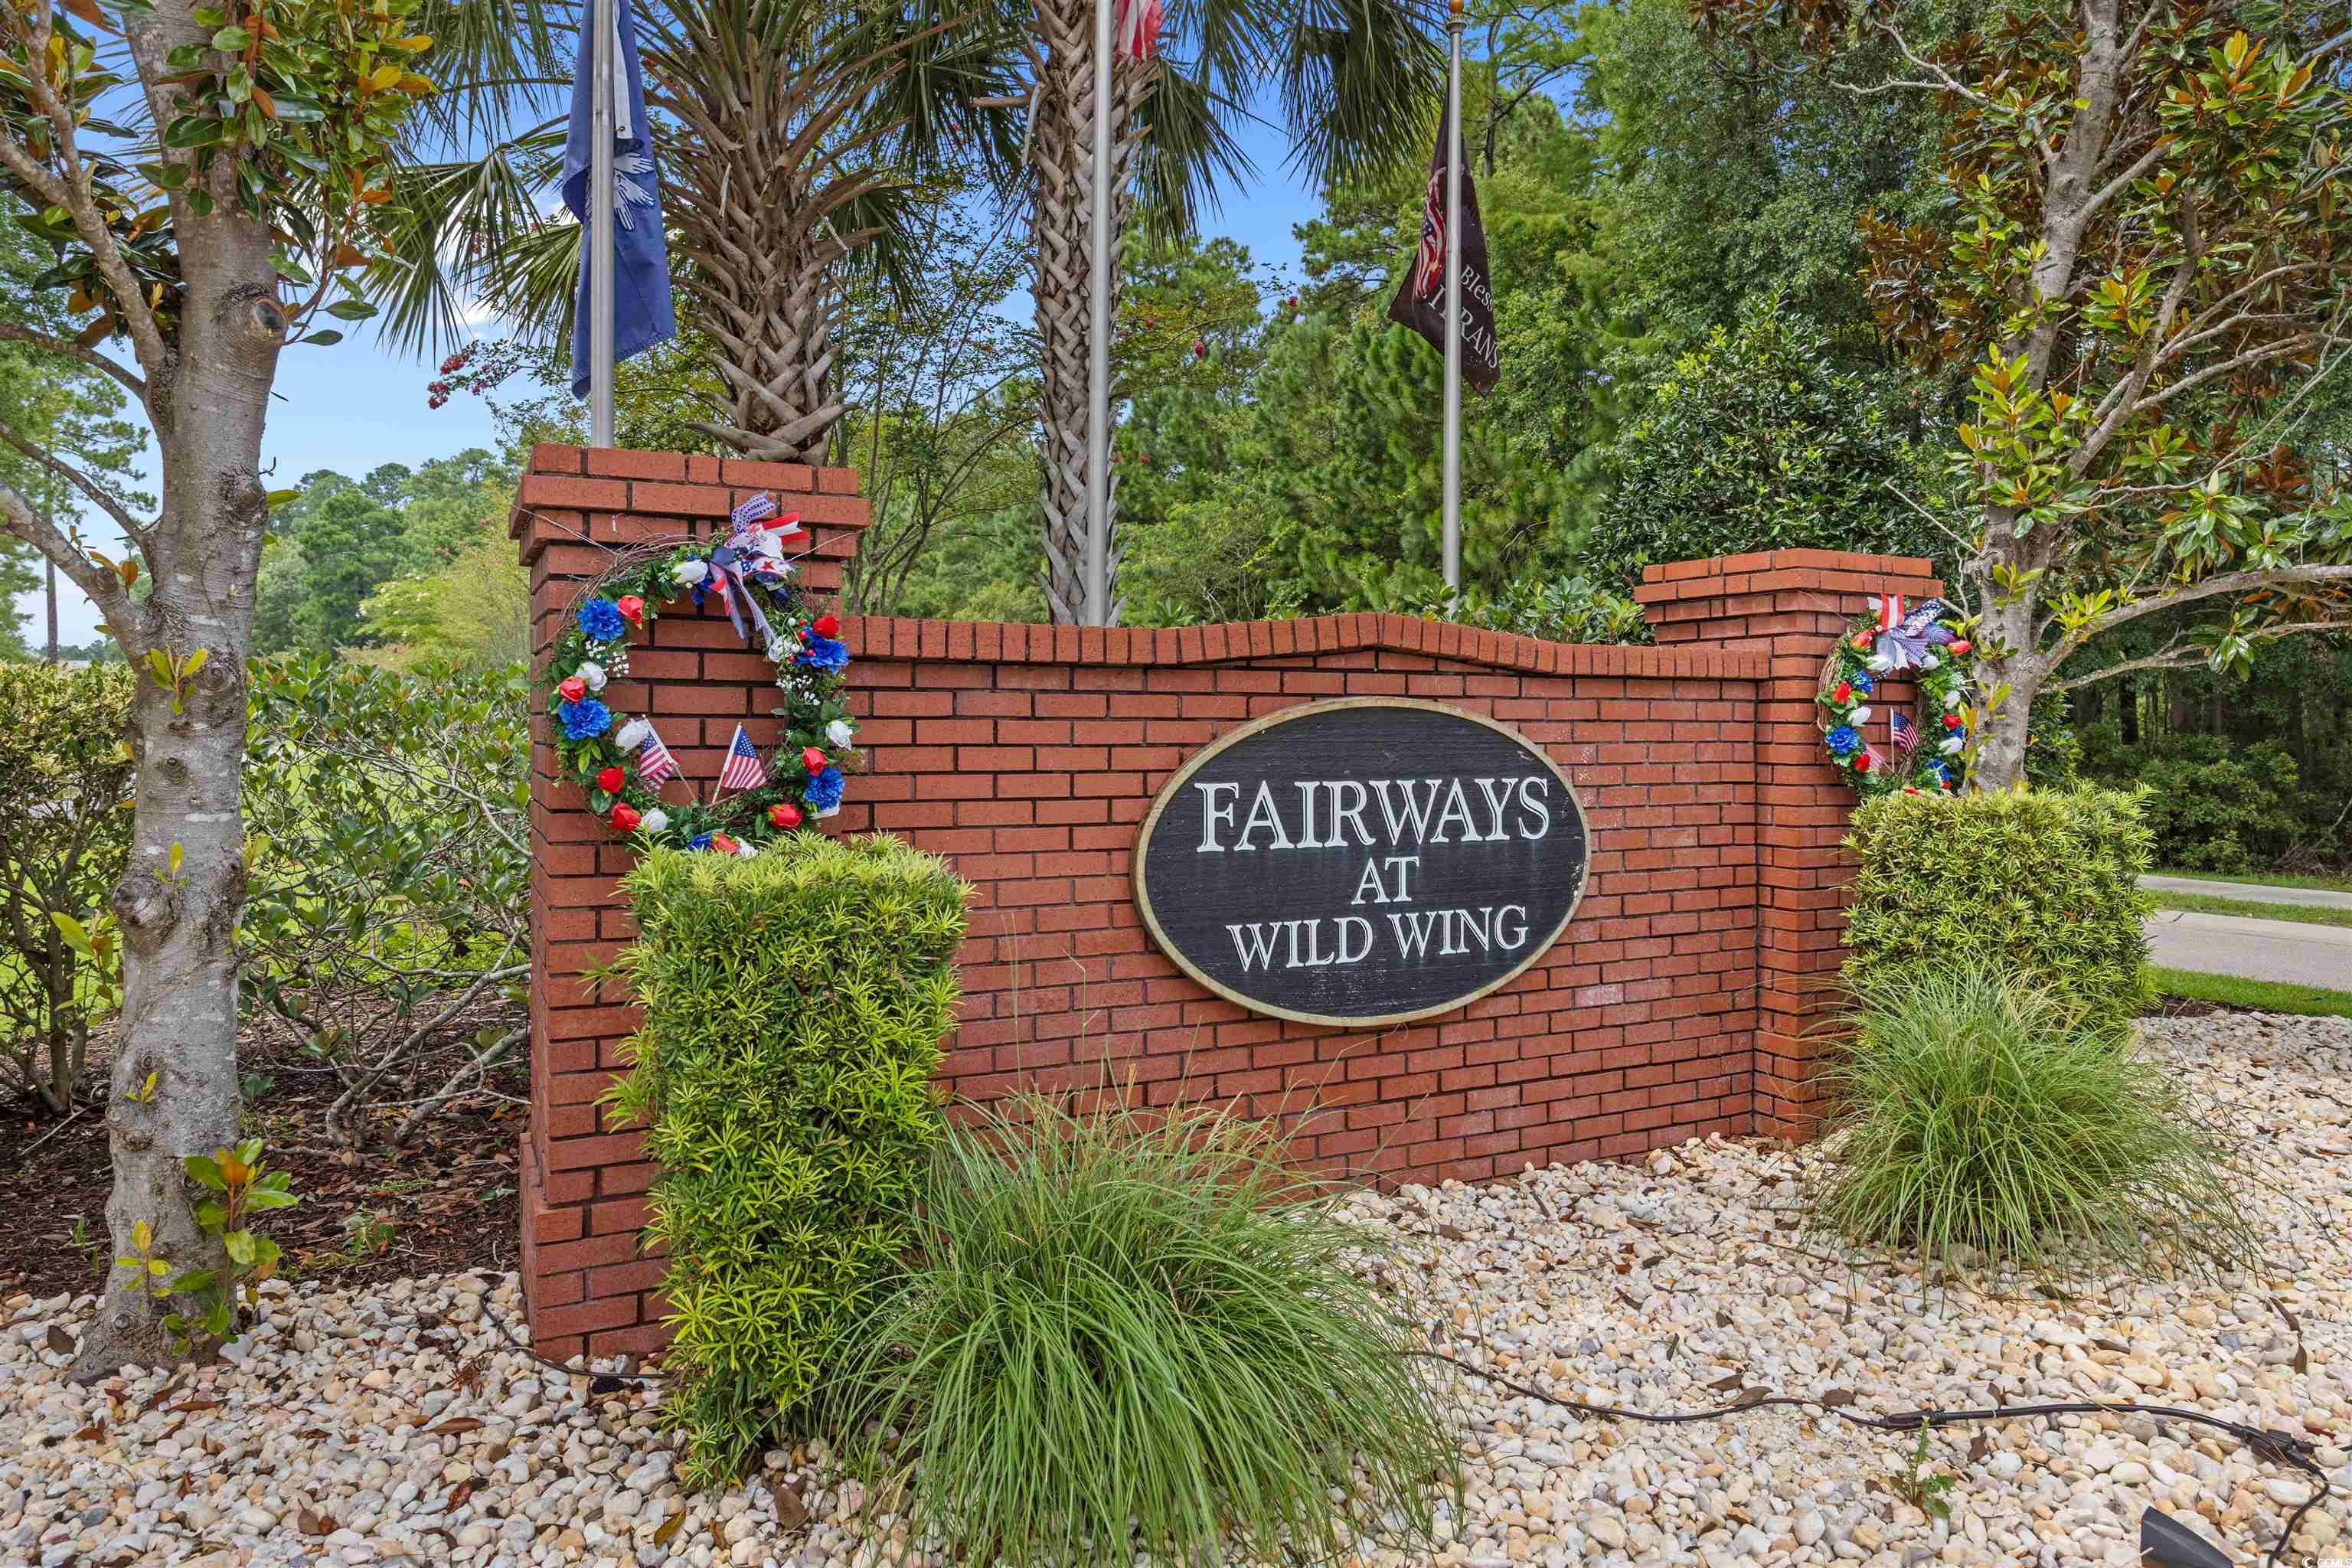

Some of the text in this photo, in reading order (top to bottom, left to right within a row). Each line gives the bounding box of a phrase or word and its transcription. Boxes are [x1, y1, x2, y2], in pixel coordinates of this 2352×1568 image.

[1194, 776, 1550, 852] FAIRWAYS
[1351, 857, 1420, 905] AT
[1226, 905, 1529, 972] WILD WING
